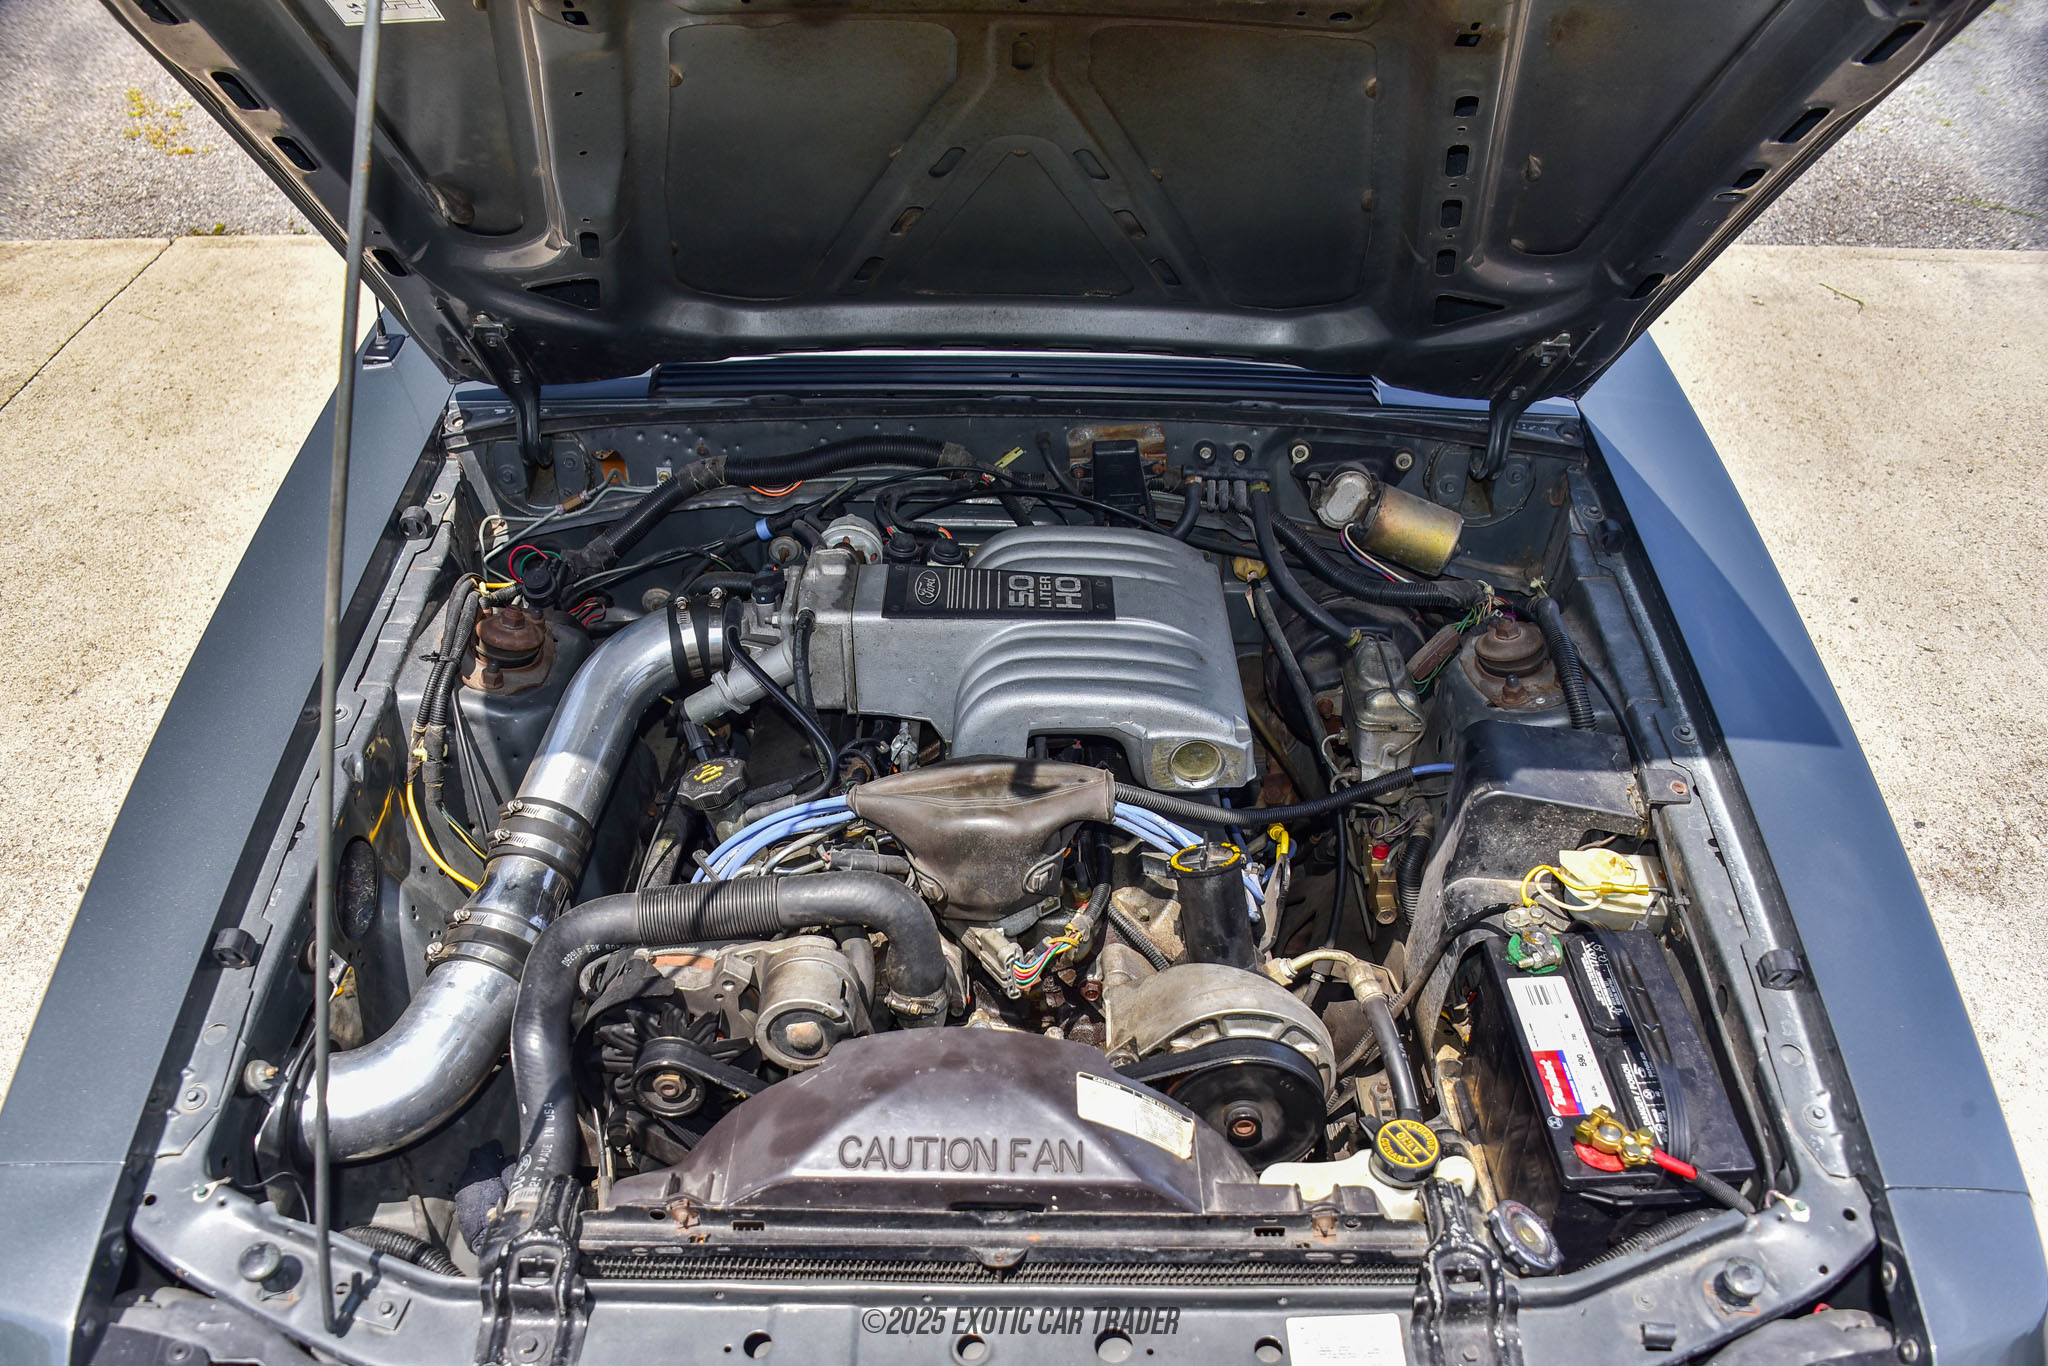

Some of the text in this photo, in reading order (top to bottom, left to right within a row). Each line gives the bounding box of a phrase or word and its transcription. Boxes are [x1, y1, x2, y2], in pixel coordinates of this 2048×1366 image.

[1008, 574, 1035, 608] 5.0
[1039, 575, 1052, 608] LITER
[1055, 576, 1082, 609] HO
[1576, 1053, 1588, 1067] 590
[1620, 1063, 1638, 1090] POISON
[543, 1102, 556, 1121] USA
[543, 1126, 555, 1137] IN
[1396, 1131, 1421, 1154] ONLY
[1406, 1122, 1435, 1151] RADIATOR
[537, 1143, 553, 1163] MADE
[838, 1135, 1084, 1173] CAUTION FAN
[1380, 1137, 1409, 1163] COOLANT
